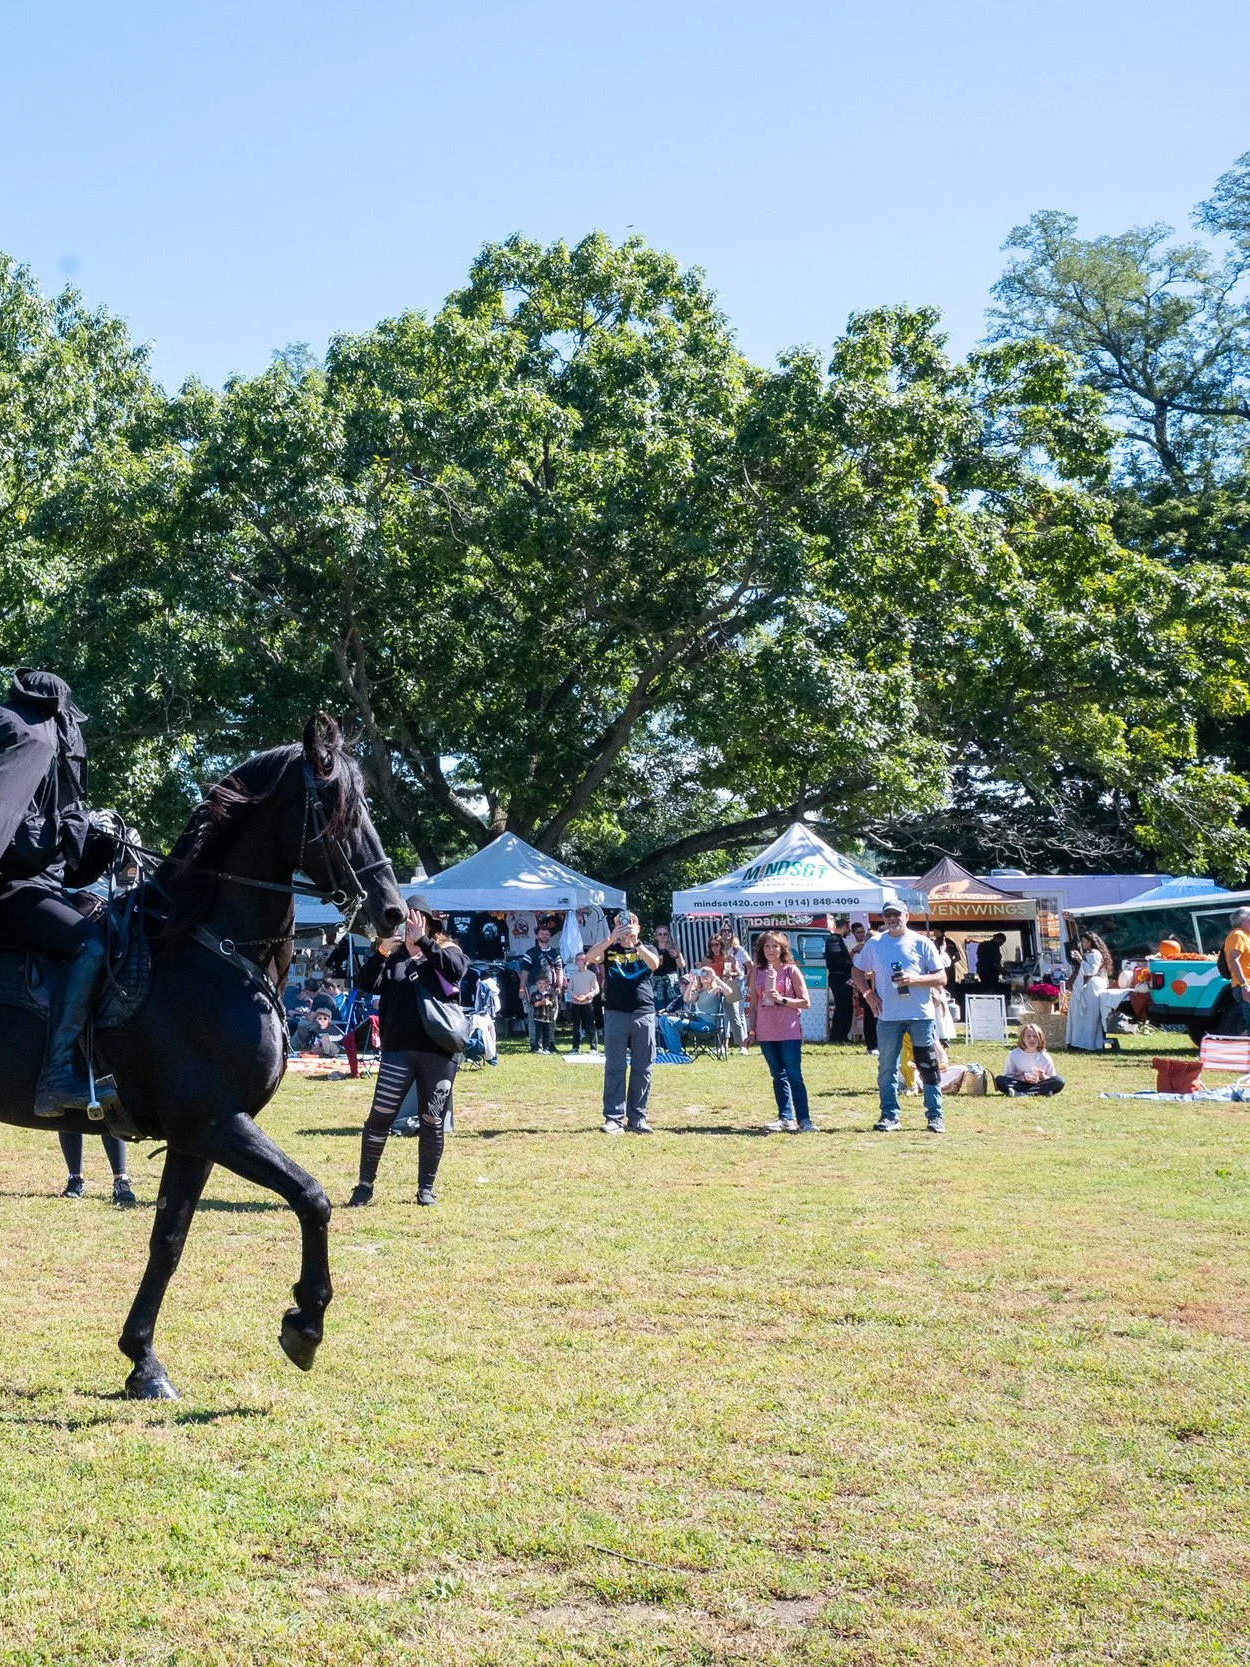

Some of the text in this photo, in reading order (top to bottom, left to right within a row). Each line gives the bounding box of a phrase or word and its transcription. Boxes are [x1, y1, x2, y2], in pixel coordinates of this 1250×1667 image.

[693, 897, 860, 908] mindset420.com (914) 848-4090
